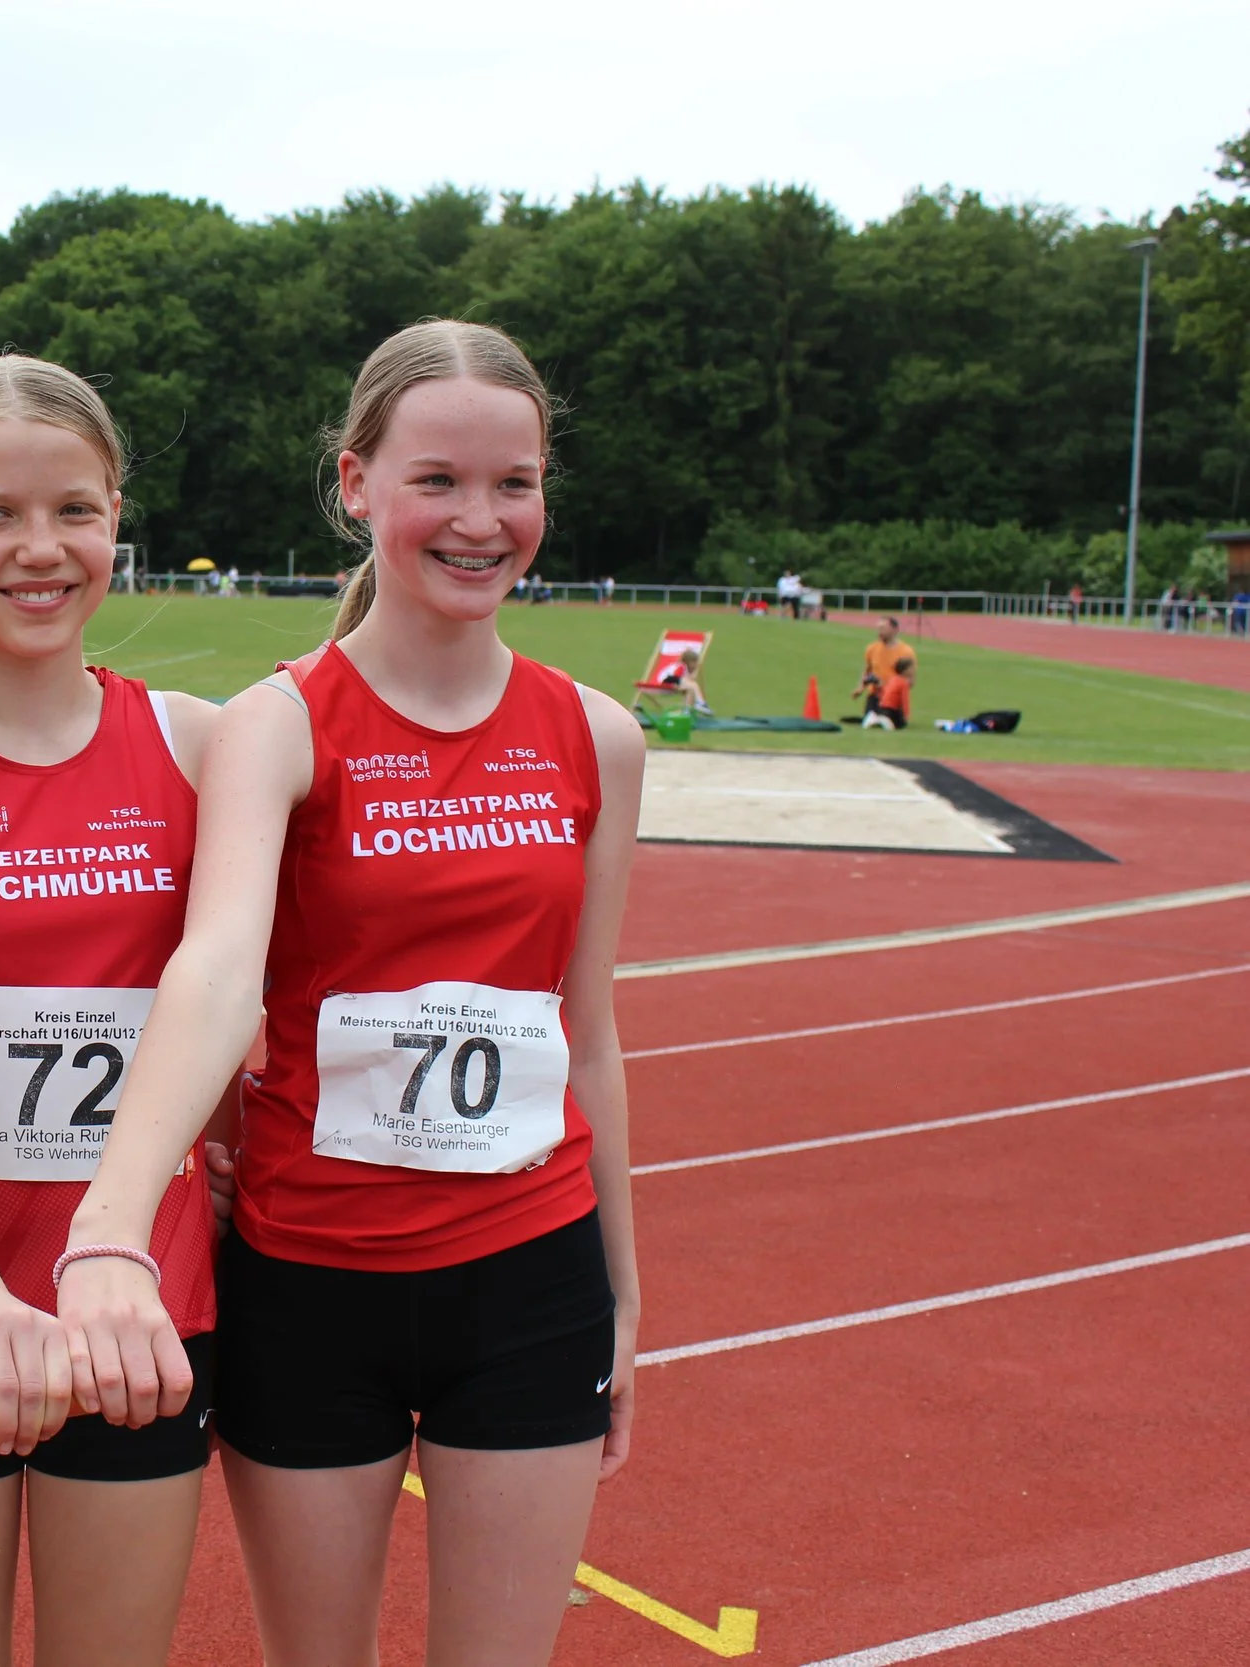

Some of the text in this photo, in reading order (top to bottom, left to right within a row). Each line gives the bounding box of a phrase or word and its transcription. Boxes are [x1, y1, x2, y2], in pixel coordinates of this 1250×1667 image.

[504, 748, 537, 759] TSG
[351, 767, 432, 783] veste lo sport
[110, 806, 141, 818] TSG
[365, 792, 558, 821] FREIZEITPARK
[87, 819, 167, 831] Wehrheim
[352, 817, 576, 857] LOCHMÜHLE
[34, 1011, 116, 1023] Kreis Einzel
[420, 1002, 497, 1020] Kreis Einzel
[52, 1028, 136, 1040] U16/U14/U12
[339, 1015, 547, 1039] Meisterschaft U16/U14/U12 2026
[8, 1042, 124, 1126] 72
[392, 1032, 501, 1120] 70
[372, 1112, 510, 1139] Marie Eisenburger
[13, 1128, 75, 1143] Viktoria
[333, 1136, 352, 1146] W13
[392, 1134, 491, 1152] TSG Wehrheim
[14, 1147, 103, 1160] TSG Wehrhei
